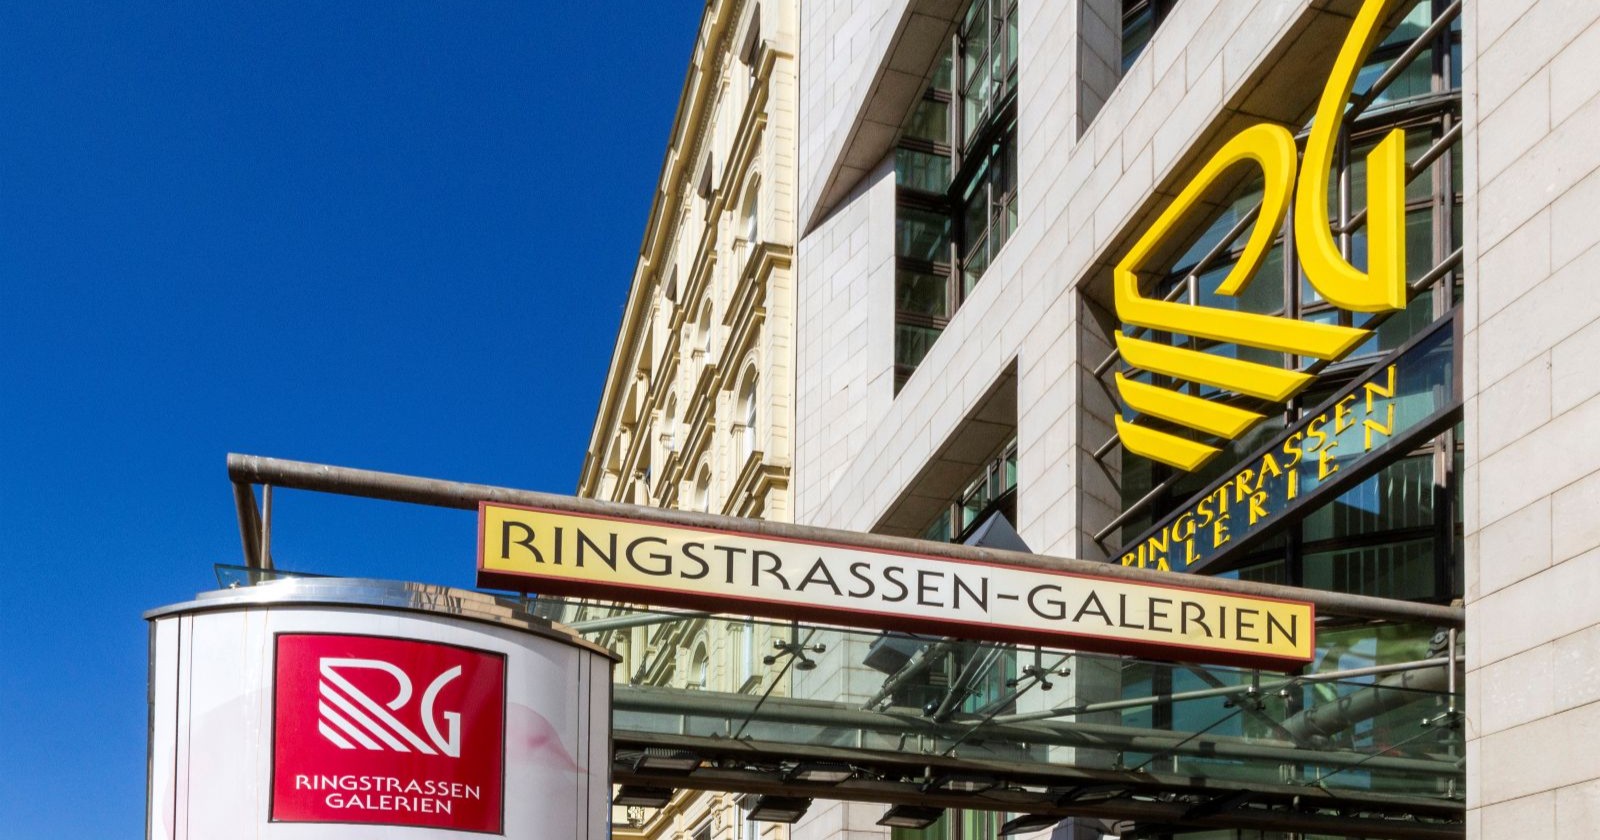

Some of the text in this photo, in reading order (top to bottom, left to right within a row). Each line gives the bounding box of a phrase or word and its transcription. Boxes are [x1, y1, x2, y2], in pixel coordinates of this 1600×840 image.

[1156, 403, 1396, 572] ALERIEN
[501, 520, 1298, 648] RINGSTRASSEN-GALERIEN
[318, 657, 462, 758] RG
[295, 774, 480, 800] RINGSTRASSEN
[325, 792, 452, 815] GALERIEN
